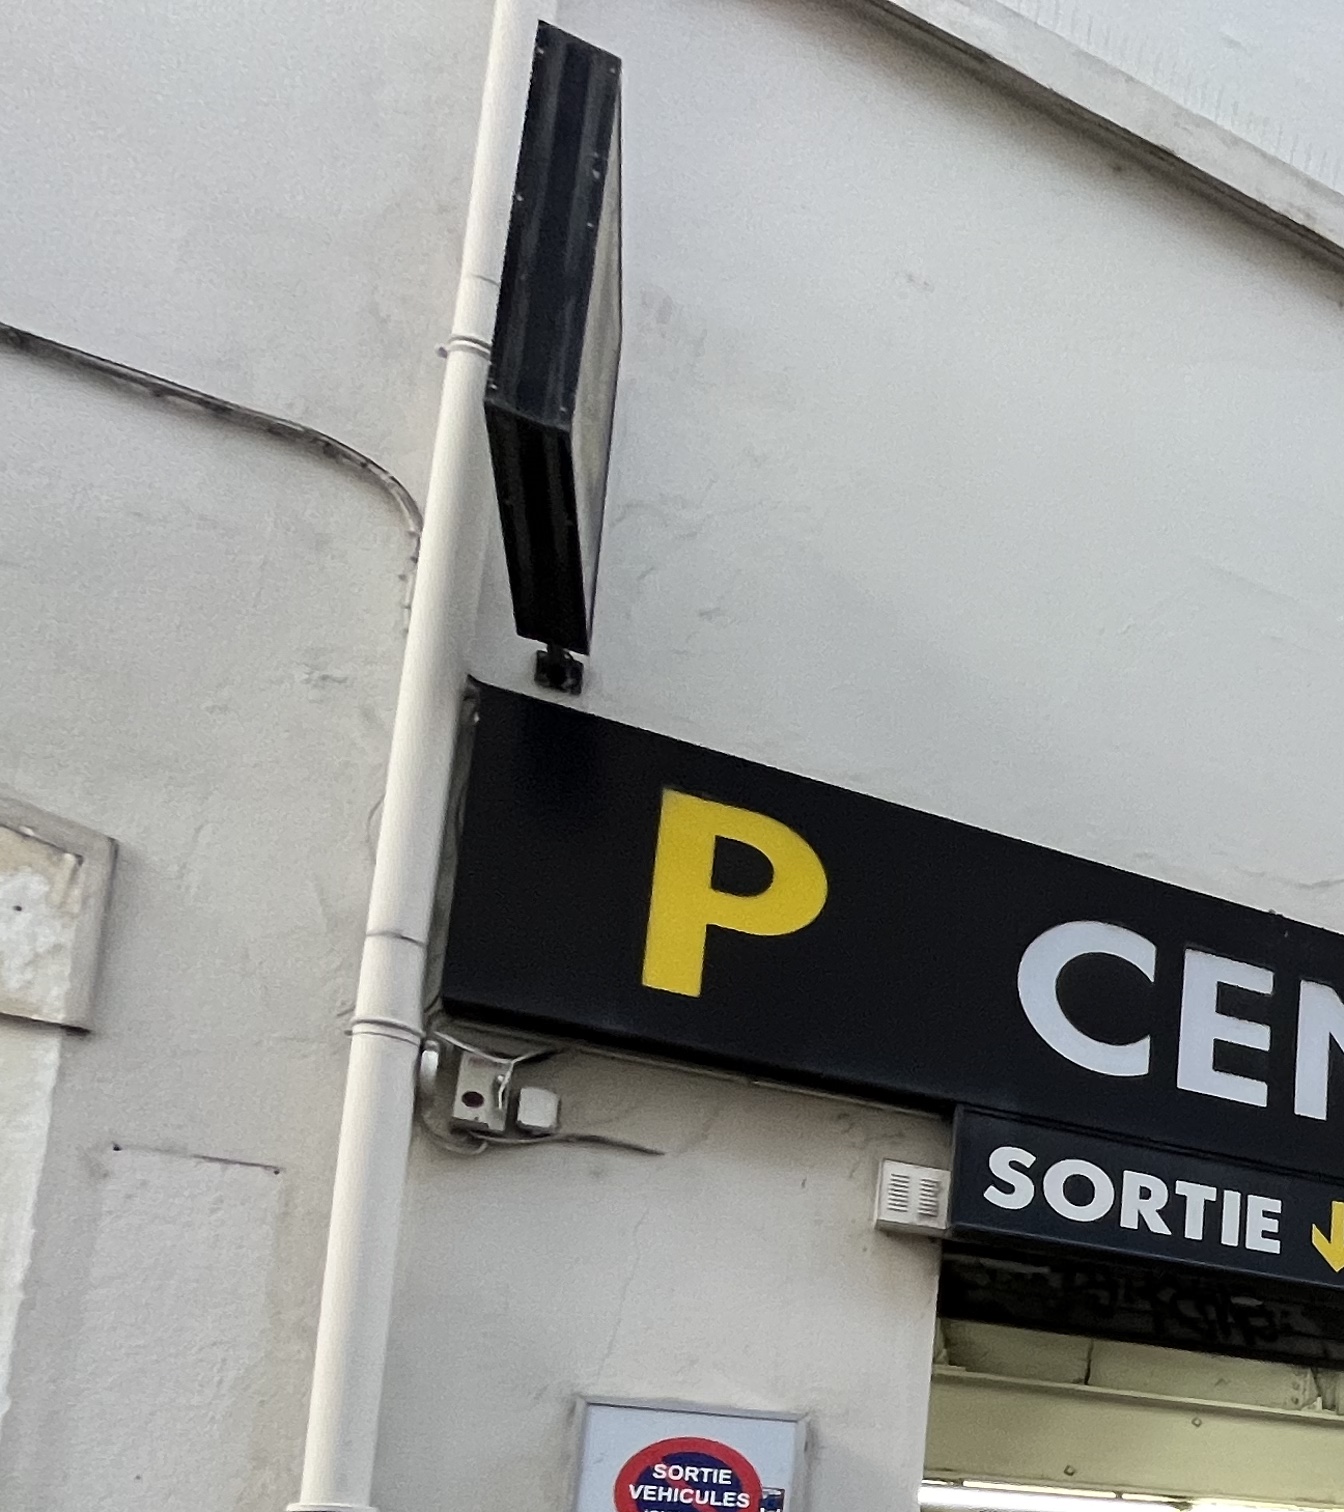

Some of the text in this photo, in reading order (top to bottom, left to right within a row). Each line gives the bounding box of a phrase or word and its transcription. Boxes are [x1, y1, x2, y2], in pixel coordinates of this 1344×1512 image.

[641, 788, 828, 998] P
[983, 1145, 1283, 1256] SORTIE
[628, 1484, 750, 1508] VEHICULES
[652, 1463, 732, 1485] SORTIE
